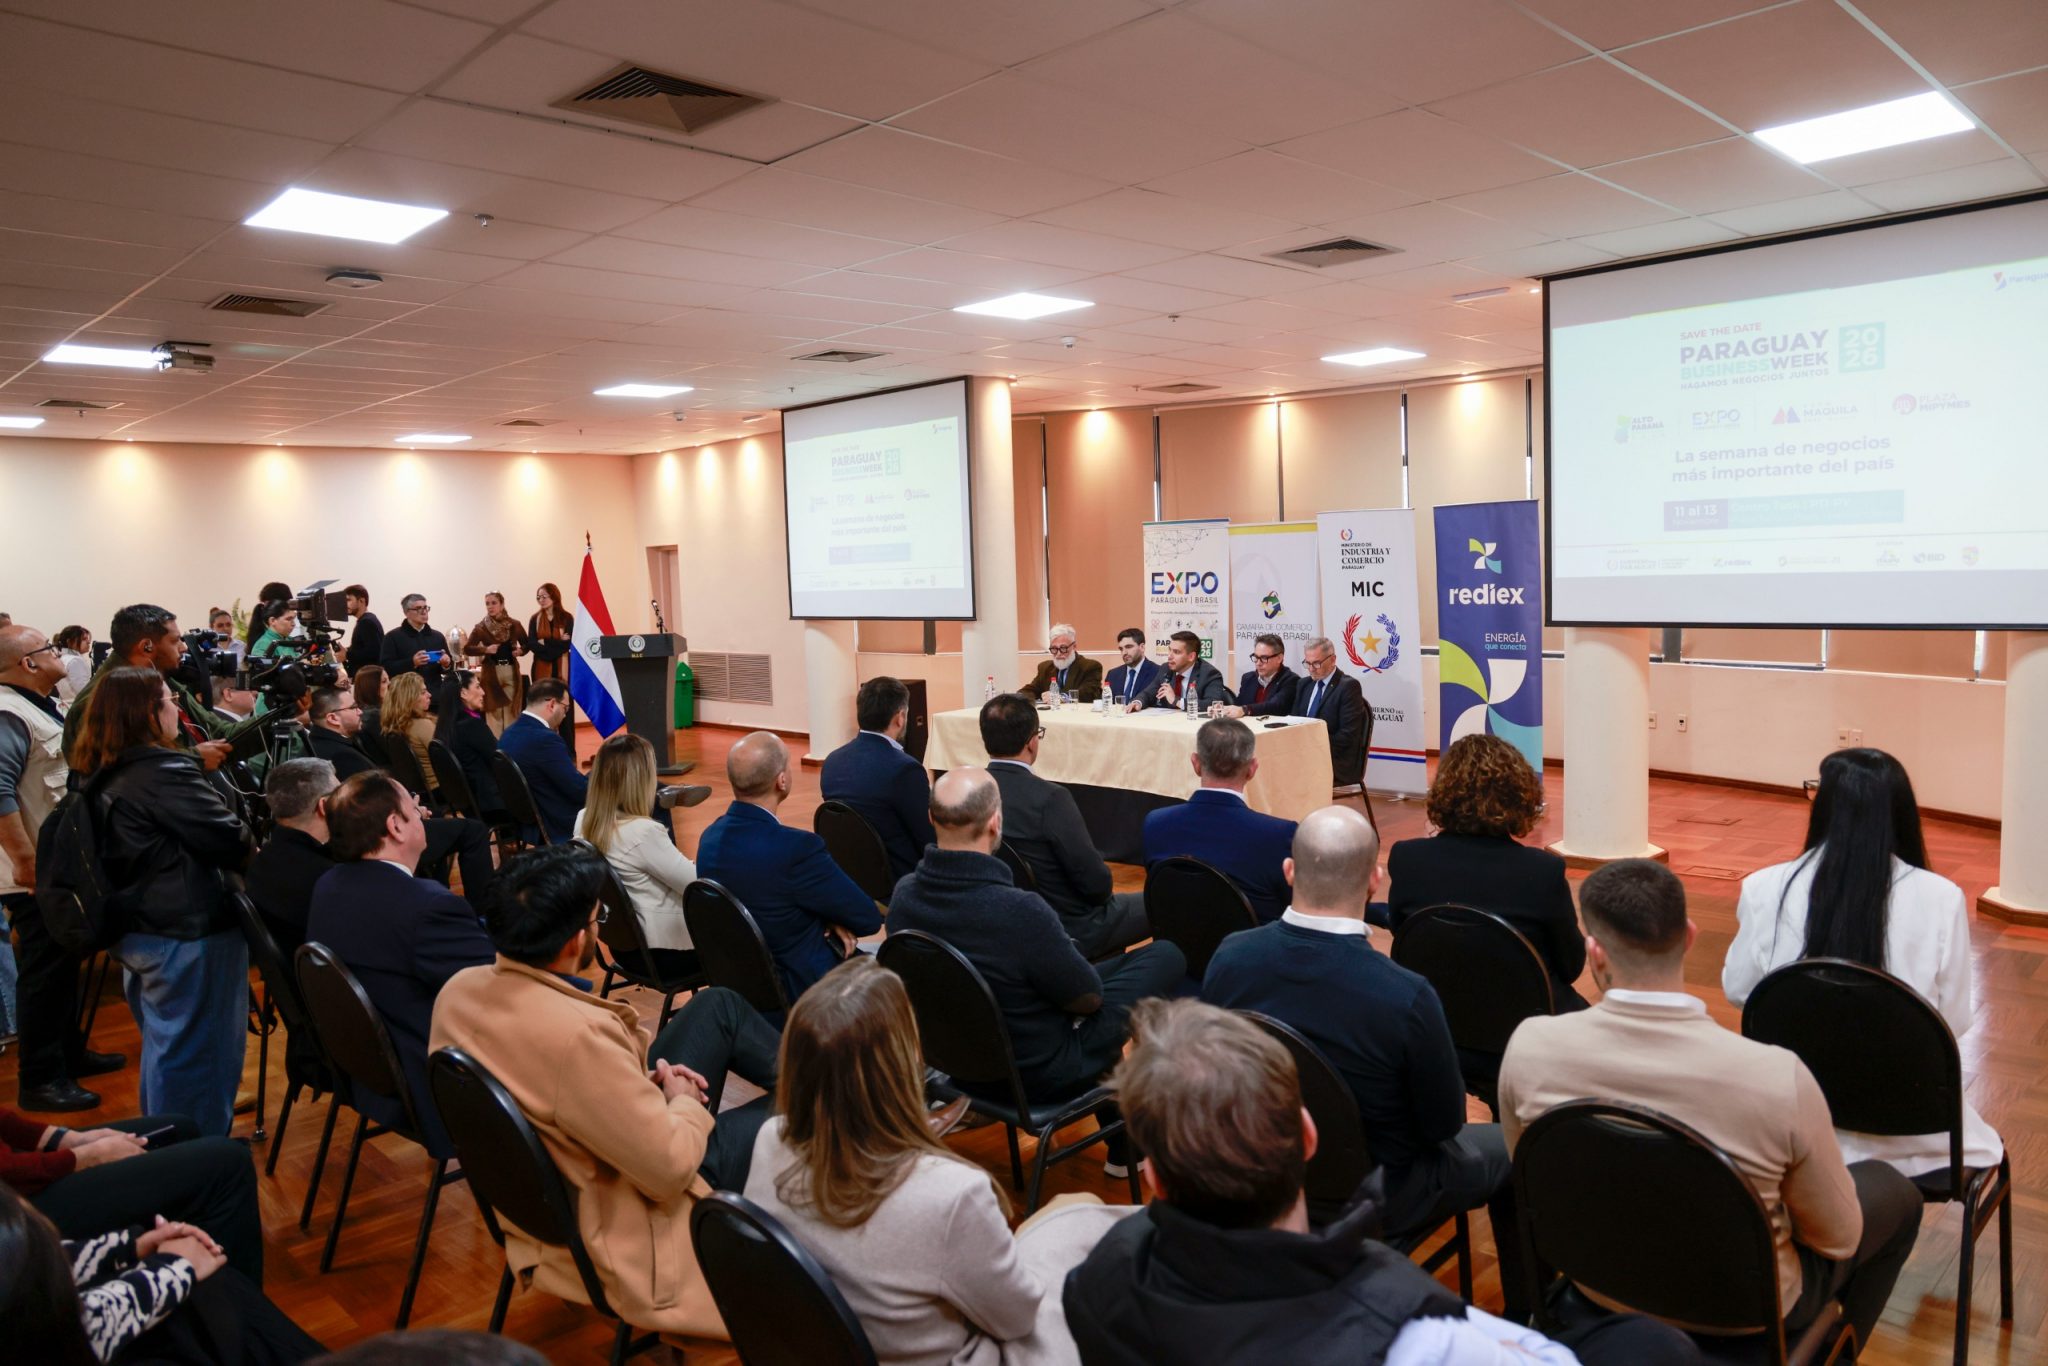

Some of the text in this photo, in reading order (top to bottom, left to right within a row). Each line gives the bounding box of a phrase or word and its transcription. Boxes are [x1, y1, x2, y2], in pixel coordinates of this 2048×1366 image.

[1680, 322, 1762, 341] SAVE THE DATE
[1845, 327, 1879, 349] 20
[1680, 329, 1829, 364] PARAGUAY
[1845, 348, 1879, 368] 26
[1680, 368, 1829, 391] HAGAMOS NEGOCIOS JUNTOS
[1692, 409, 1741, 426] EXPO
[832, 449, 882, 467] PARAGUAY
[1675, 436, 1891, 464] La semana de negocios
[1672, 455, 1894, 482] más importante del país
[1688, 505, 1700, 516] al
[1704, 504, 1718, 516] 13
[1341, 547, 1391, 556] INDUSTRIA Y
[1151, 571, 1219, 595] EXPO
[1351, 581, 1385, 597] MIC
[1195, 596, 1219, 604] BRASIL
[1449, 583, 1525, 605] rediex
[1266, 623, 1275, 631] DE
[1283, 632, 1312, 641] BRASIL
[1485, 632, 1527, 643] ENERGÍA
[1200, 641, 1211, 649] 20
[1200, 649, 1211, 657] 26
[1485, 644, 1498, 652] que
[1372, 713, 1405, 722] RAGUAY
